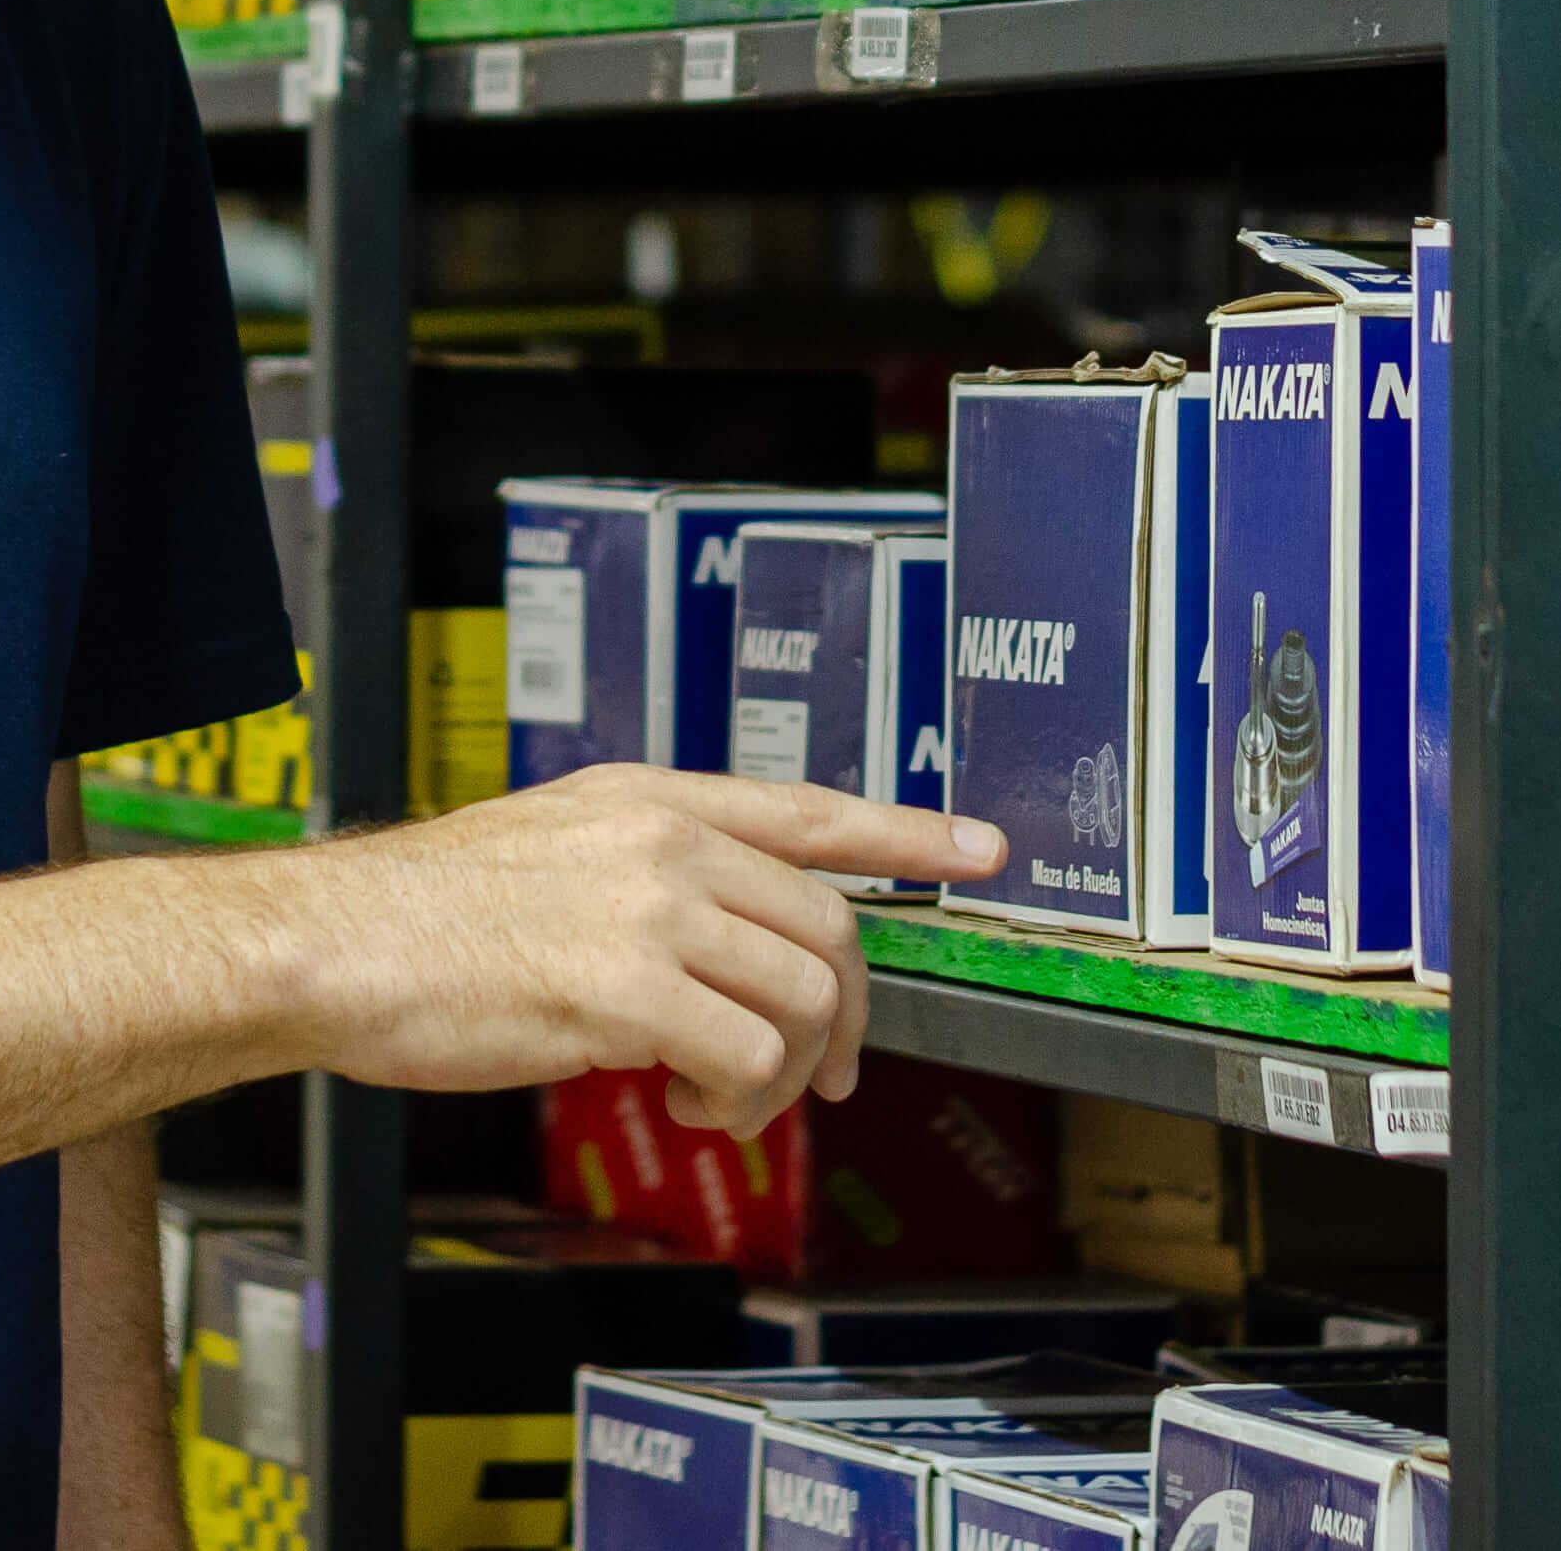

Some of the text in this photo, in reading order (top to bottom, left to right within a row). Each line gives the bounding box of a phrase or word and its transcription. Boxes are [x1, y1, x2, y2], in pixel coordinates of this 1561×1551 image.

[1032, 859, 1121, 897] Maza de Rueda
